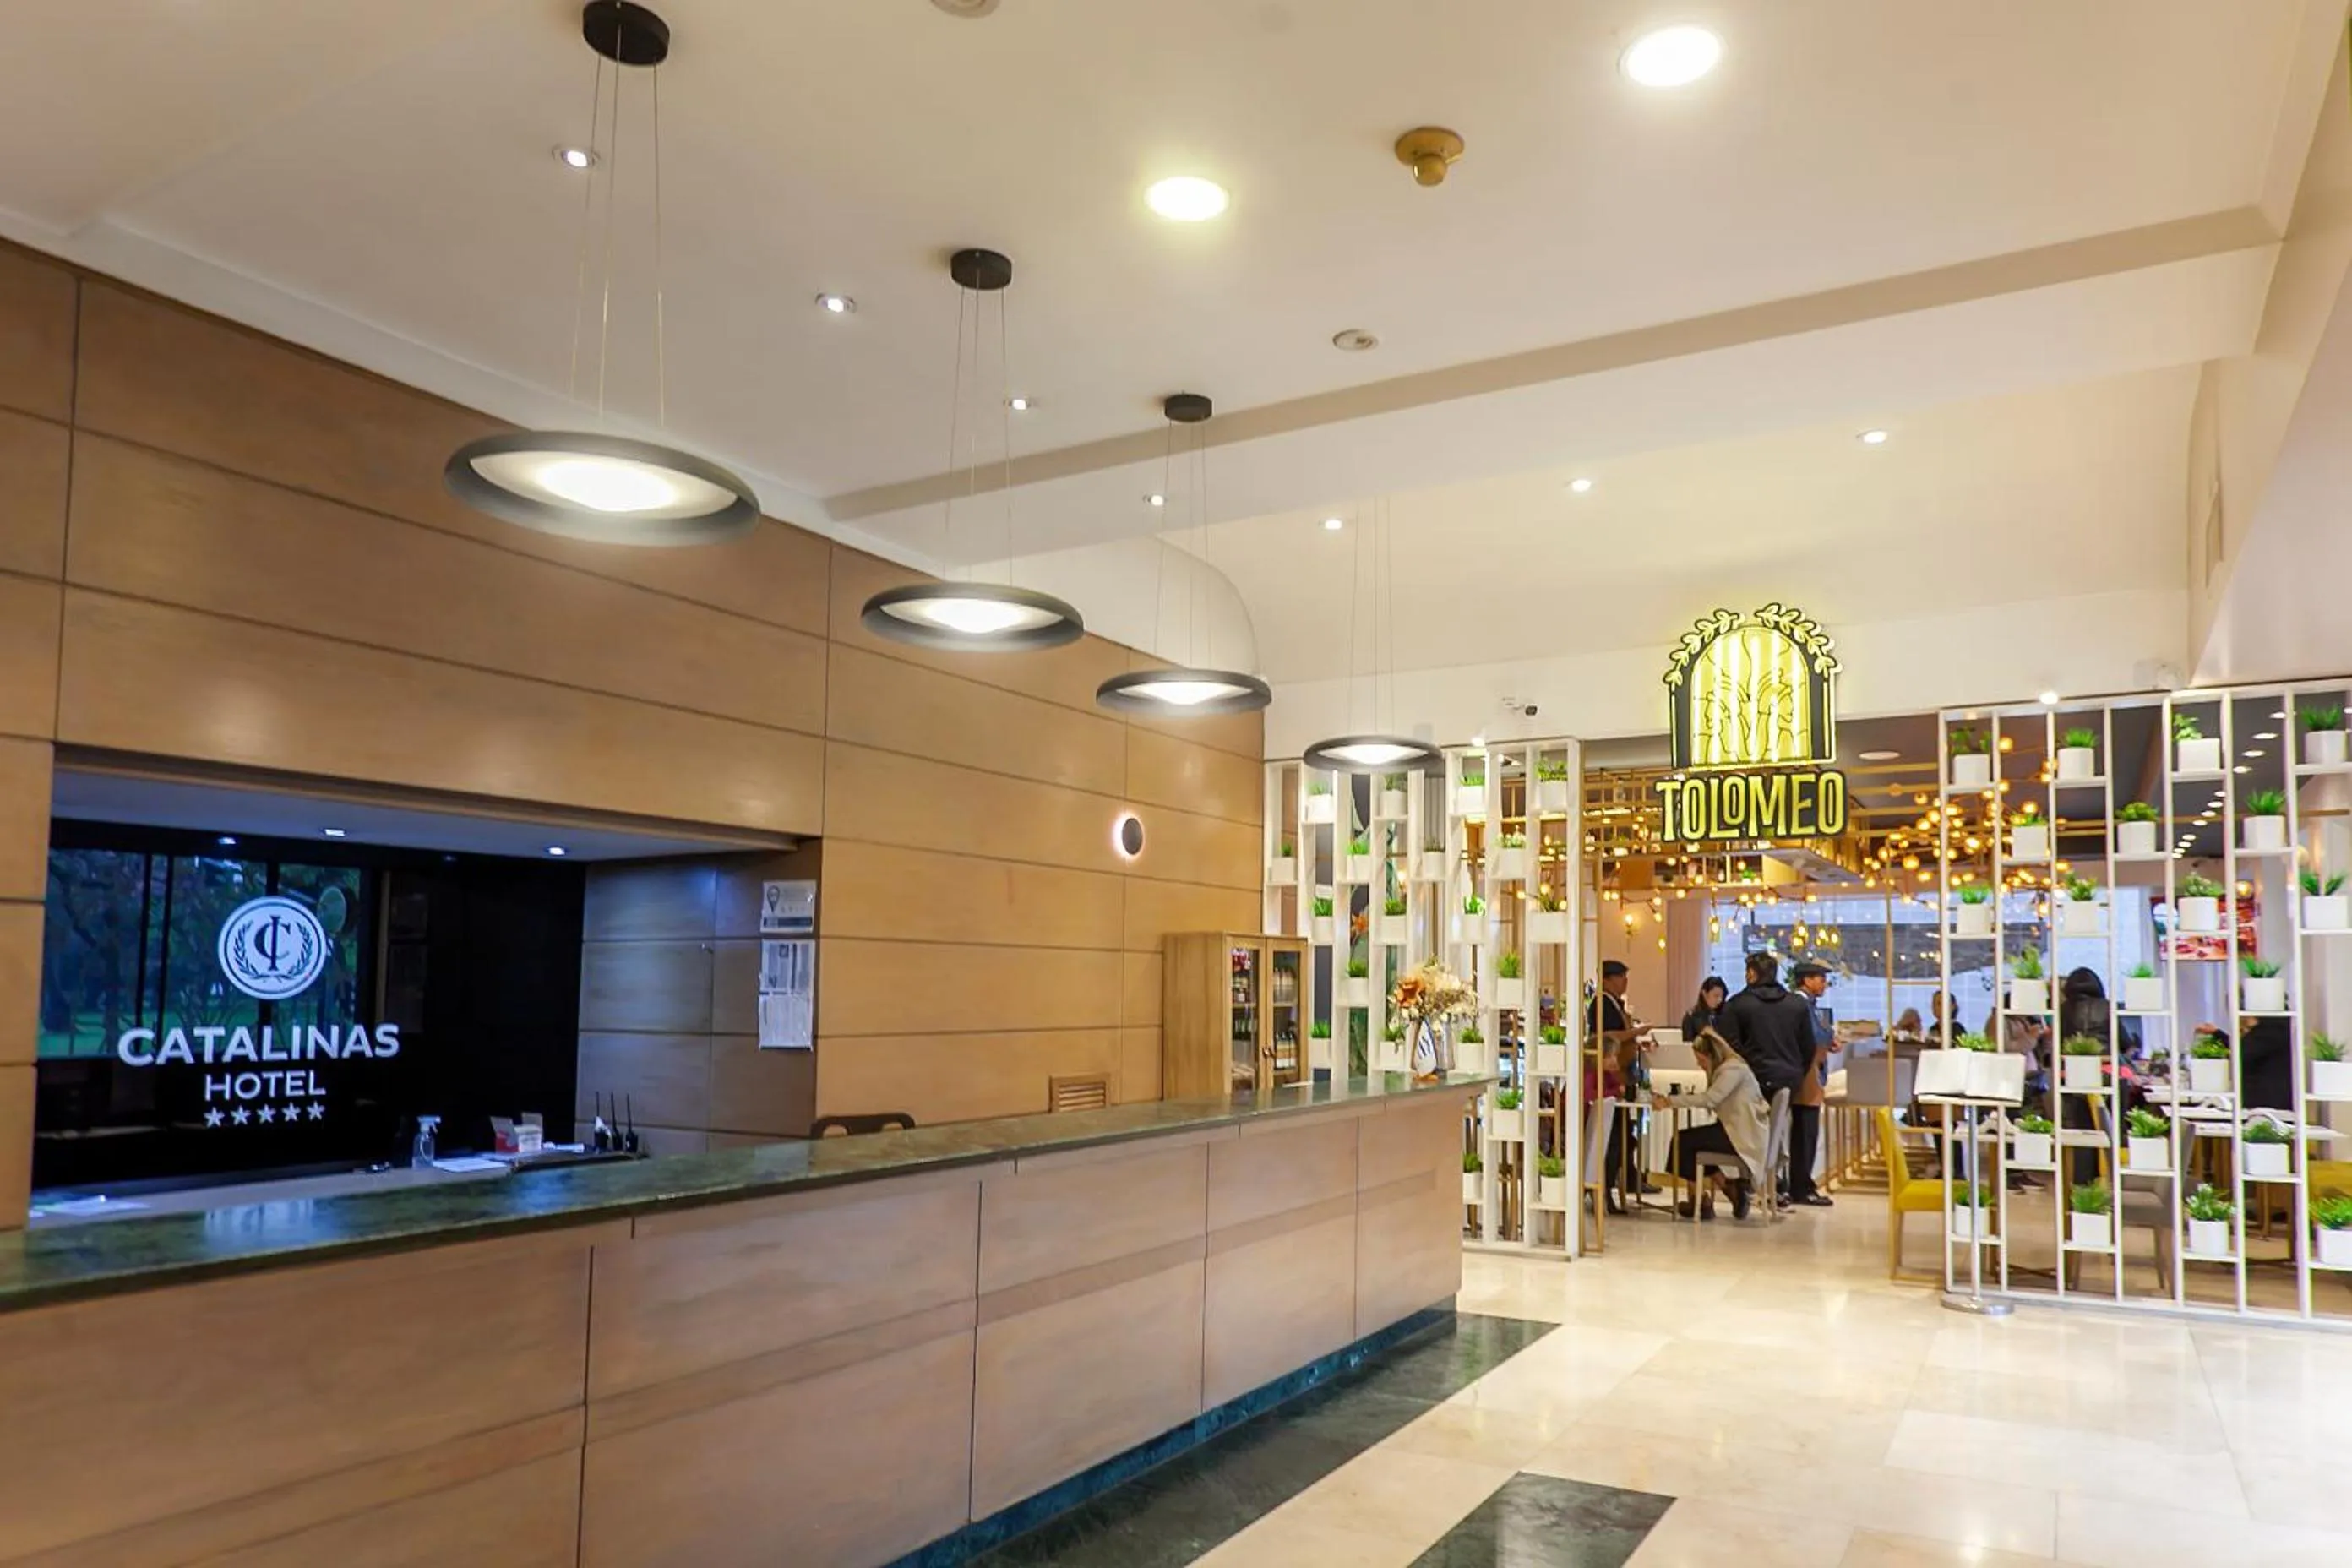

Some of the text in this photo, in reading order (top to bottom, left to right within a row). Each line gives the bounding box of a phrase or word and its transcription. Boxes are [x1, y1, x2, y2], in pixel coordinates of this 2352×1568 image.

[1654, 770, 1846, 842] TOLOMEO
[117, 1023, 400, 1066] CATALINAS
[204, 1070, 327, 1101] HOTEL
